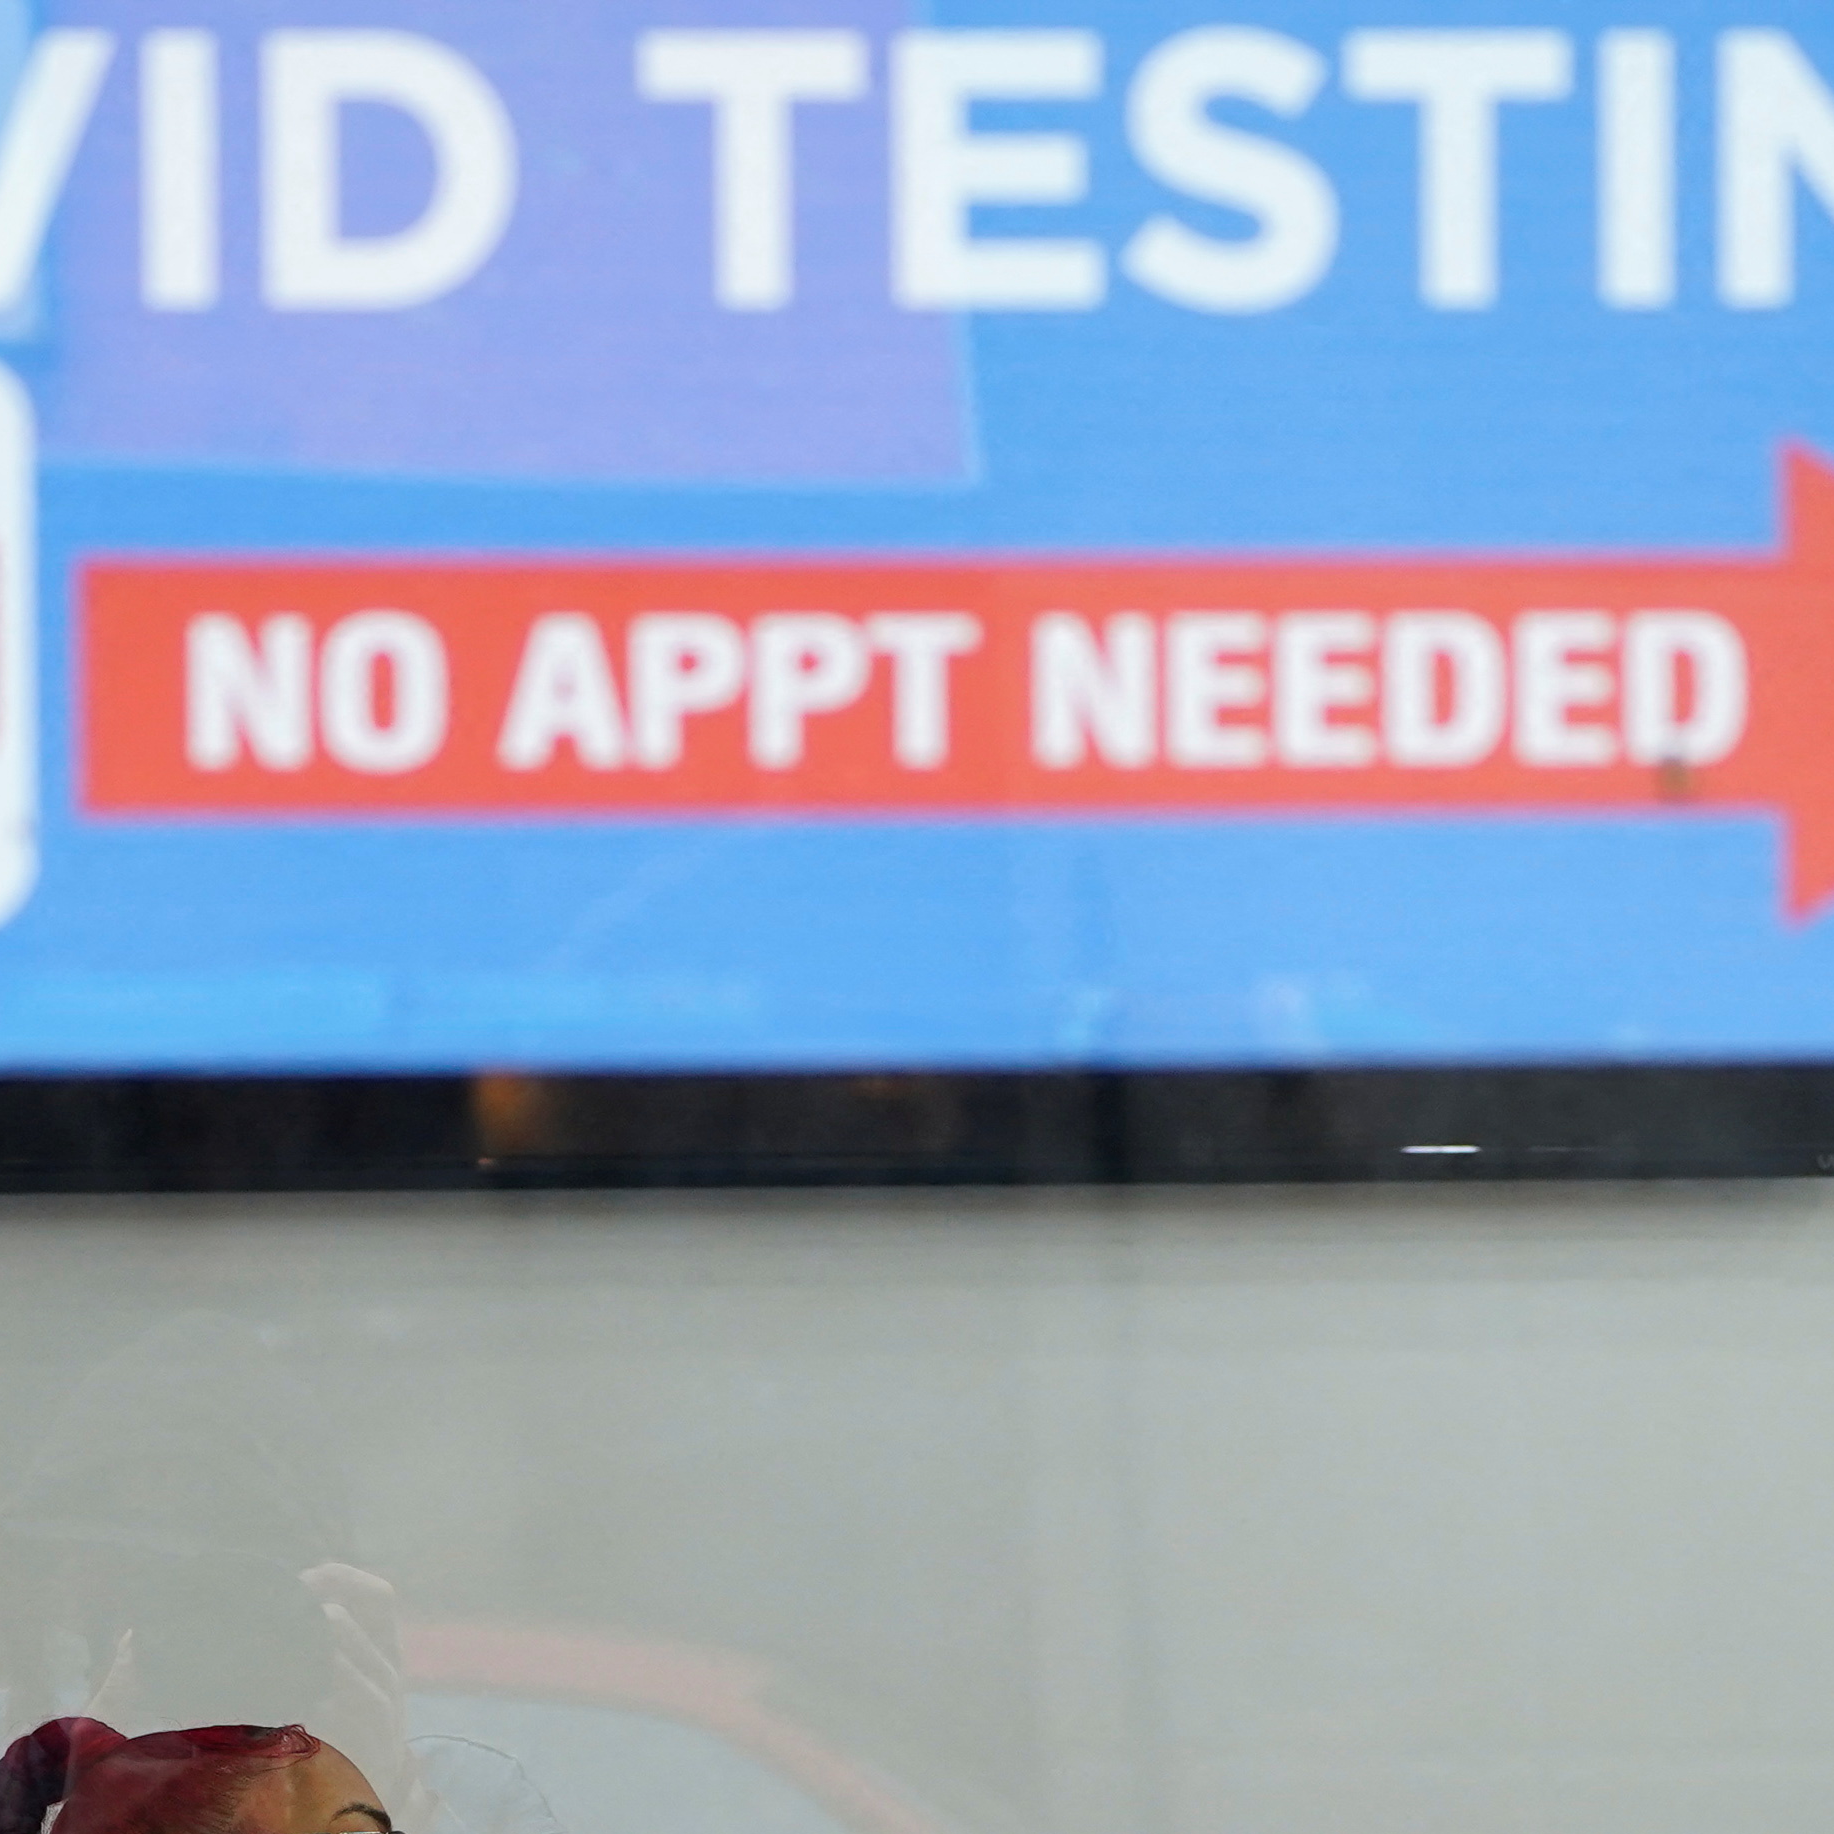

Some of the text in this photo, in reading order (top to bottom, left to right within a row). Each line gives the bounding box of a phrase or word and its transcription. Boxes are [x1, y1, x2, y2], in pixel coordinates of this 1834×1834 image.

[183, 608, 1750, 774] NO APPT NEEDED
